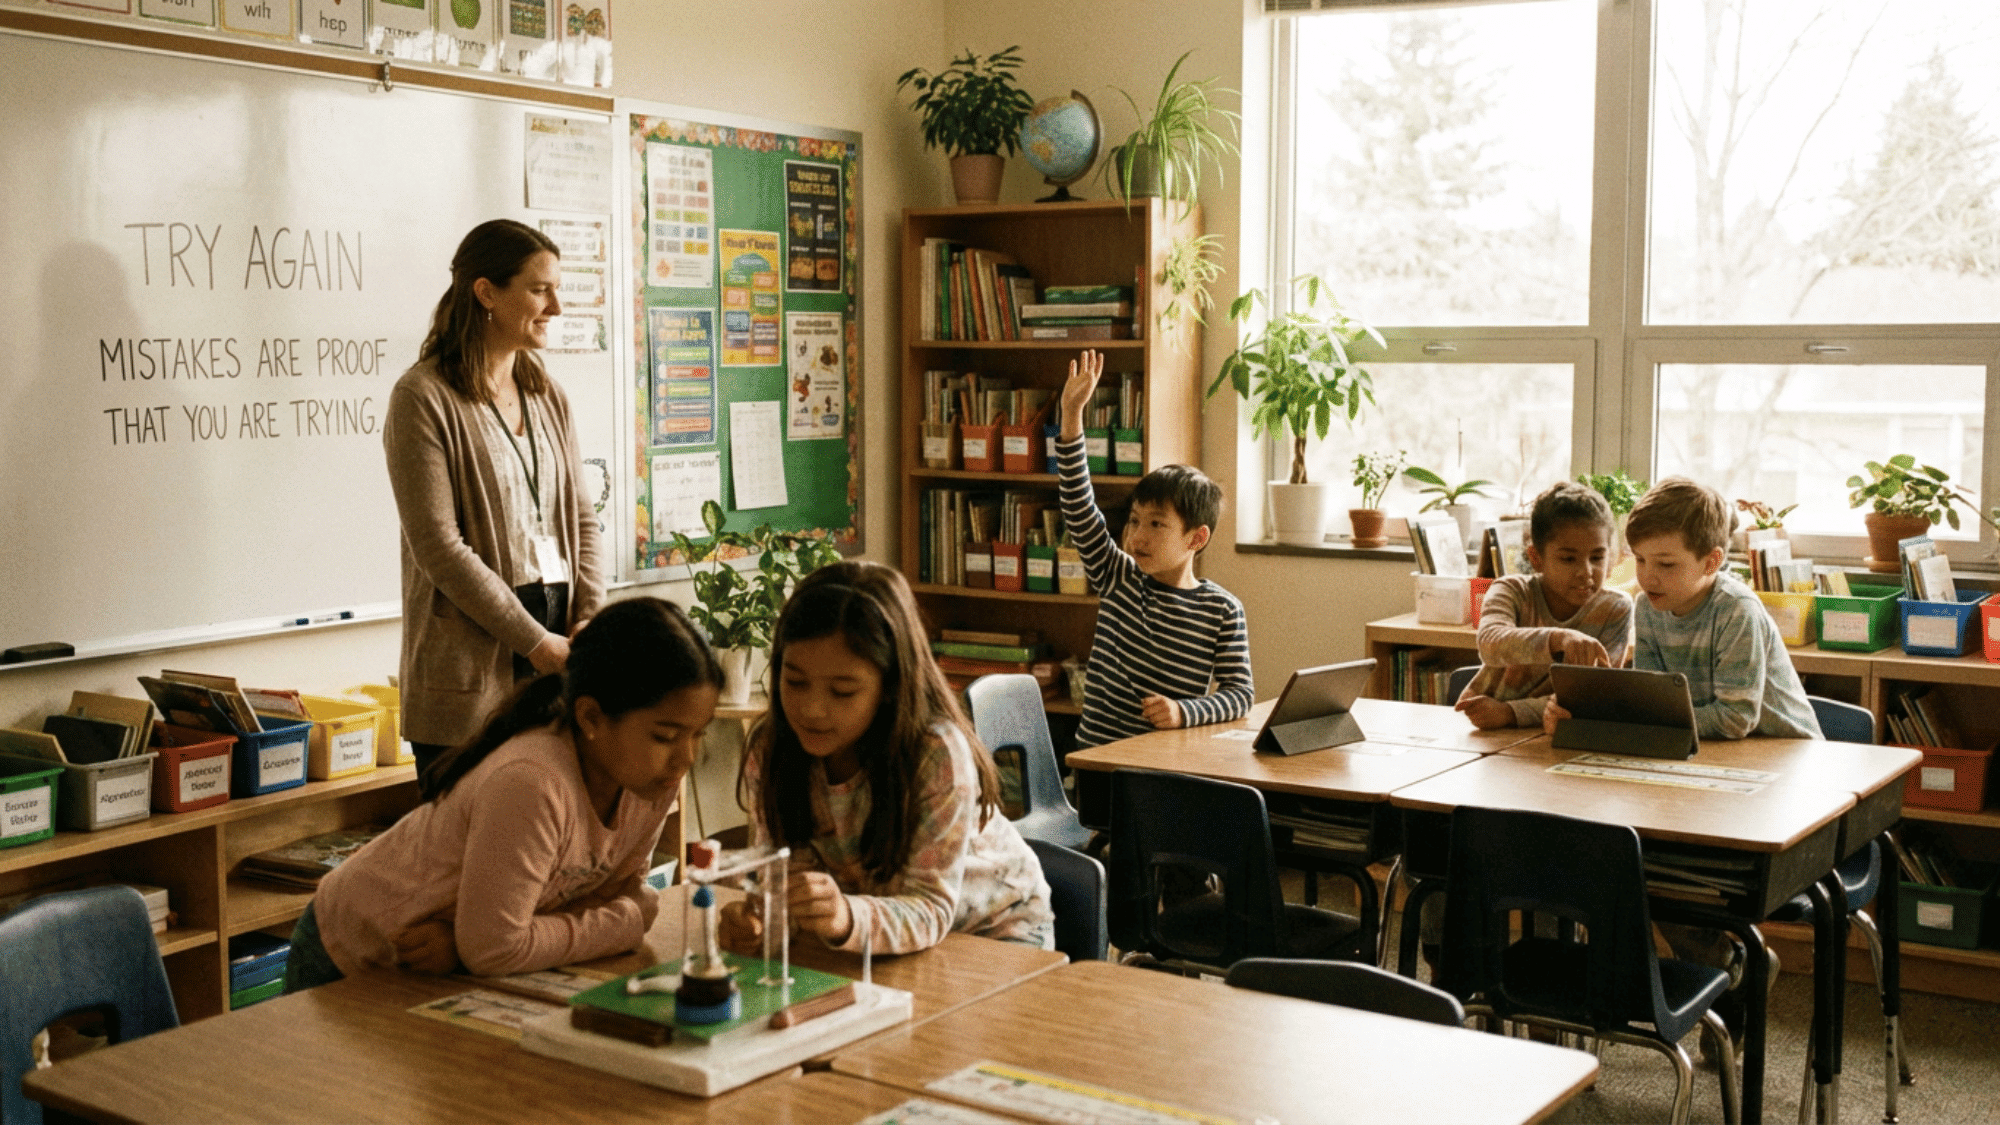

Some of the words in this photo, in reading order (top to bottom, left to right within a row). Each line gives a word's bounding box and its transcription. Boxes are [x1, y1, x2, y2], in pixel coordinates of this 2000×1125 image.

[124, 222, 222, 290] TRY
[244, 225, 362, 291] AGAIN
[100, 337, 242, 382] MISTAKES
[257, 338, 302, 378] ARE
[317, 338, 388, 377] PROOF
[103, 405, 171, 445] THAT
[182, 404, 228, 442] YOU
[239, 402, 281, 439] ARE
[289, 397, 381, 437] TRYING.
